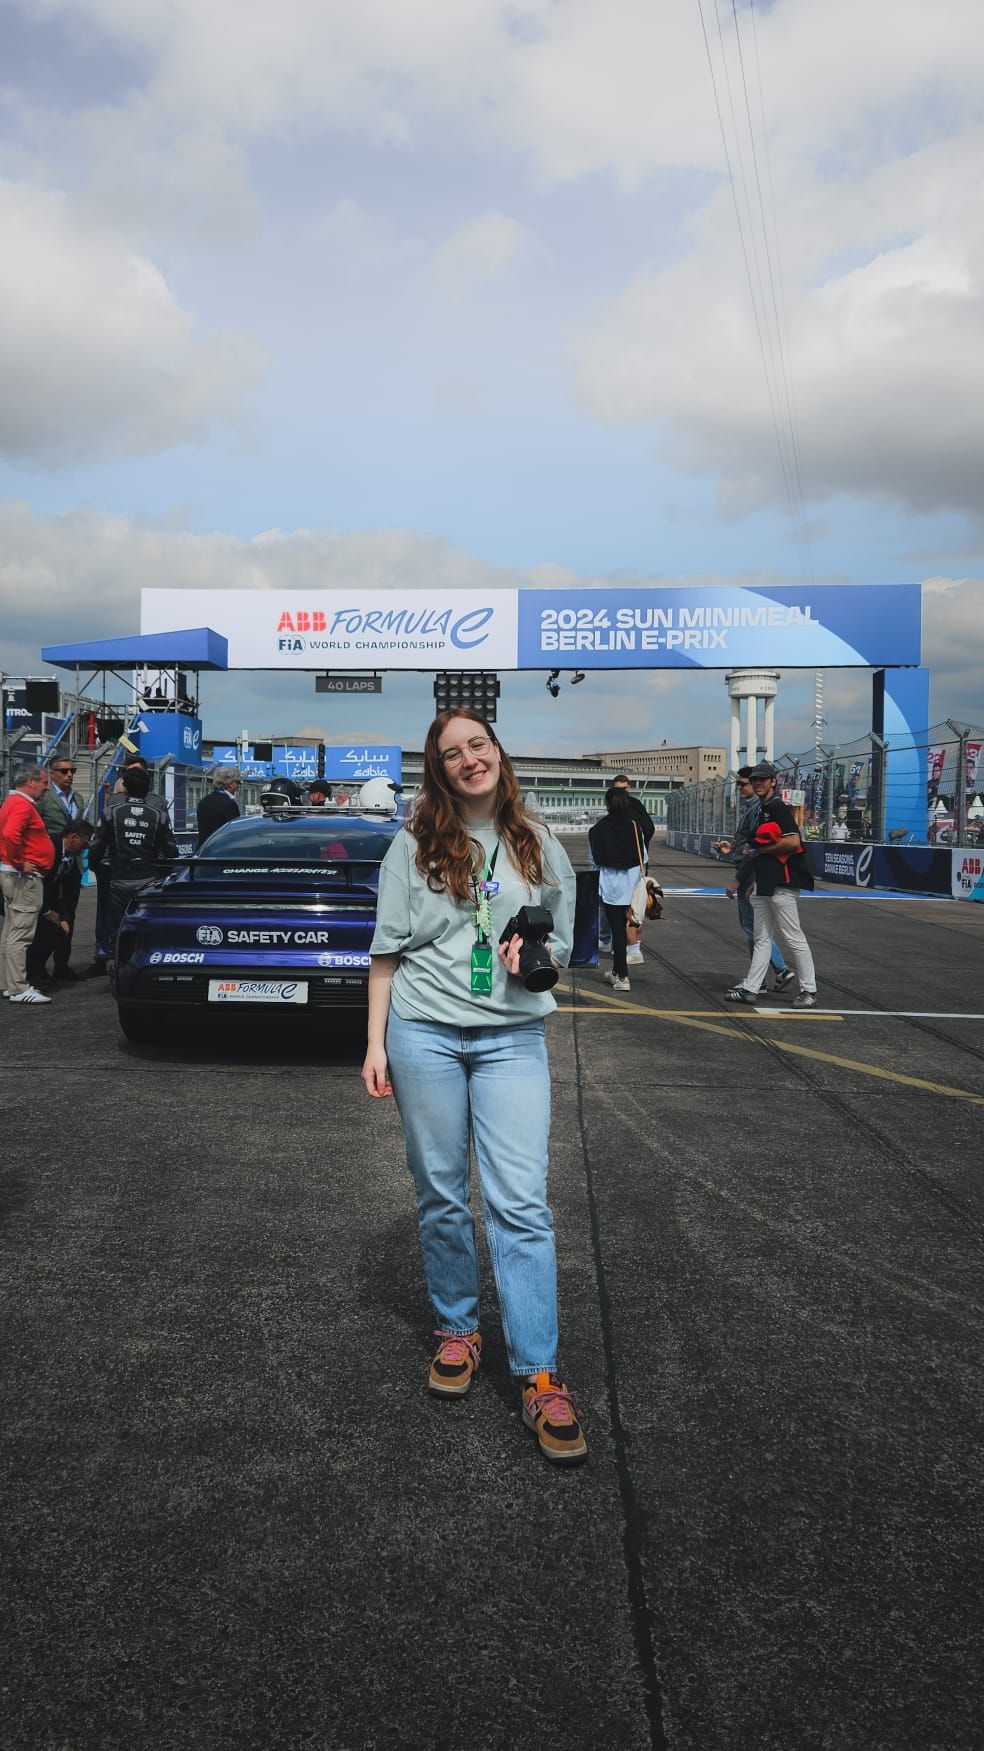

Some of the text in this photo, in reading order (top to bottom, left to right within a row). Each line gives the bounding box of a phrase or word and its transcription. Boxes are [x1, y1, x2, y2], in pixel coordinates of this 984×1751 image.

[277, 611, 327, 632] ABB
[330, 608, 454, 636] FORMULA
[540, 605, 819, 630] 2024 SUN MINIMEAL
[310, 641, 351, 649] WORLD
[355, 641, 446, 649] CHAMPIONSHIP
[540, 629, 729, 651] BERLIN E-PRIX
[327, 681, 375, 691] 40 LAPS
[962, 858, 981, 875] ABB
[227, 931, 293, 944] SAFETY
[294, 931, 329, 944] CAR
[163, 953, 204, 964] BOSCH
[217, 983, 236, 992] ABB
[237, 982, 282, 993] FORMULA
